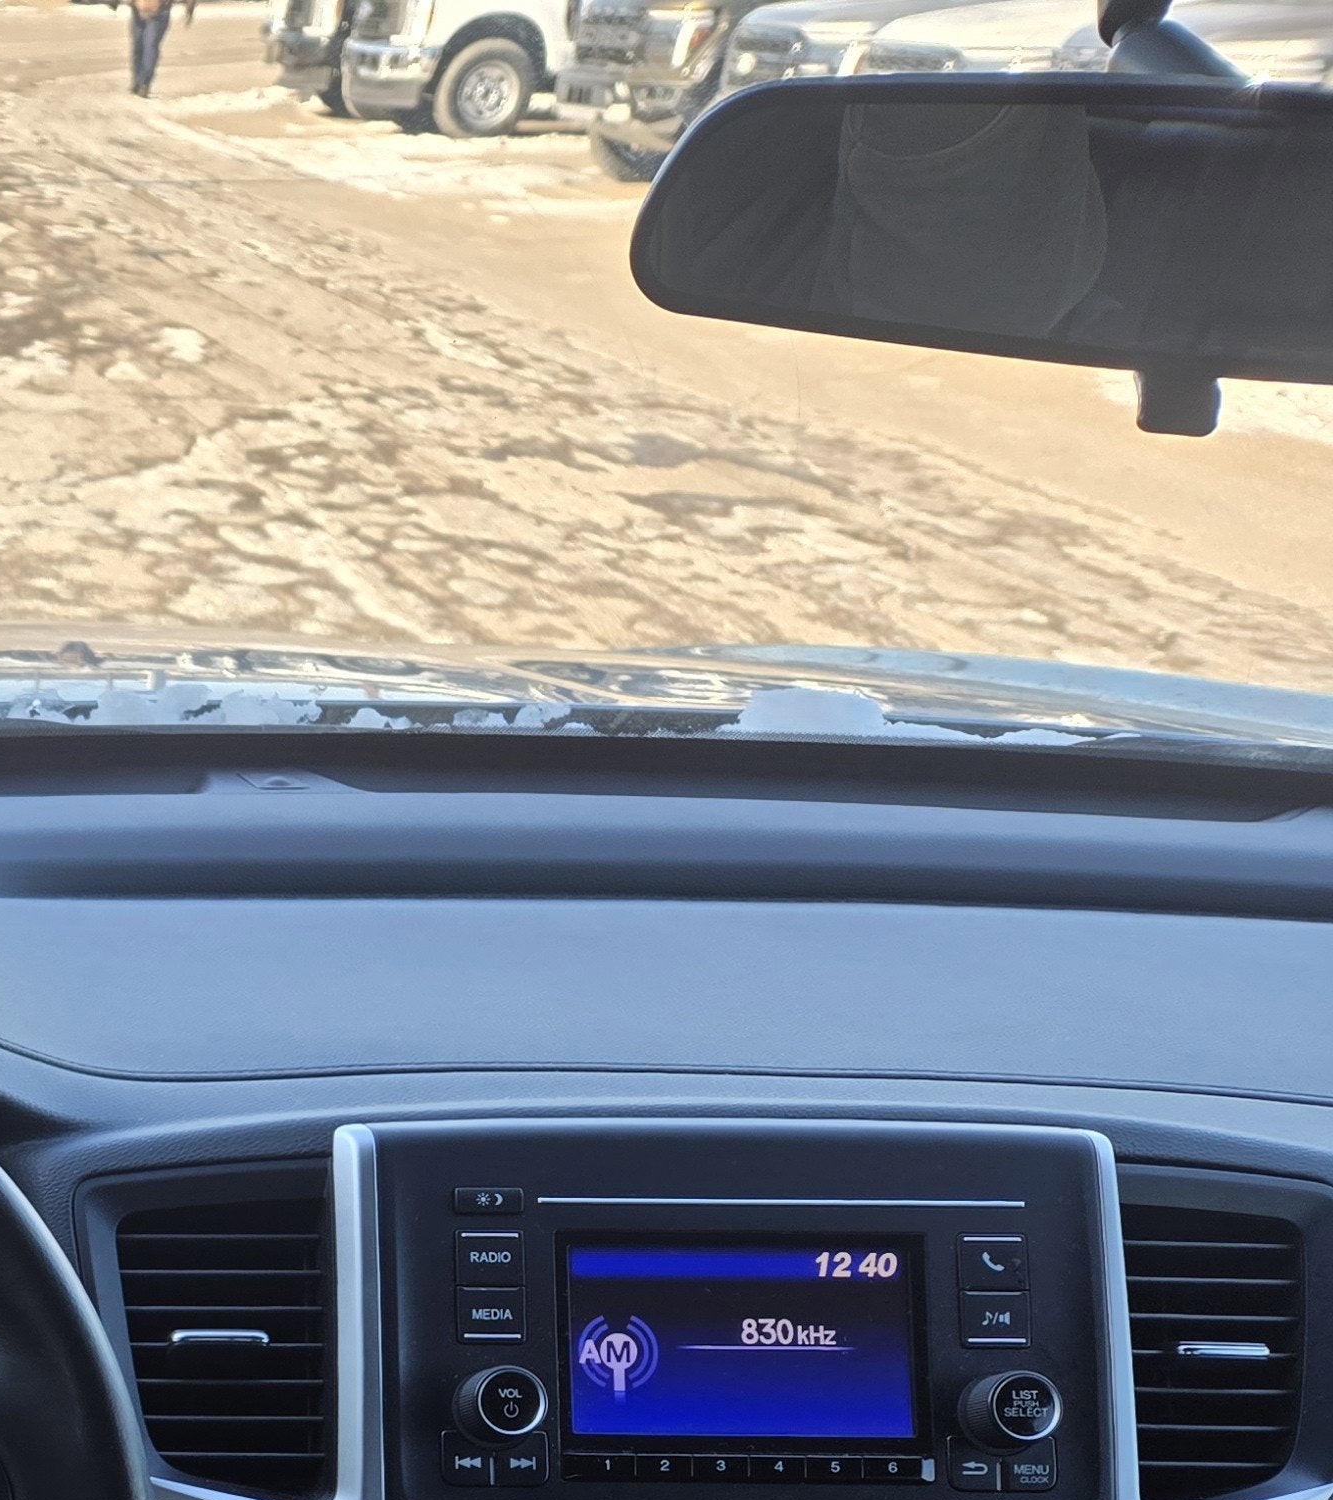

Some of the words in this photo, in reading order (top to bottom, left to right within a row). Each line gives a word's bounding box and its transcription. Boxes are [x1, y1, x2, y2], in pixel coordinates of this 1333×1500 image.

[469, 1251, 512, 1263] RADIO
[471, 1308, 514, 1320] MEDIA
[740, 1318, 795, 1345] 830
[796, 1324, 837, 1346] kHz
[498, 1388, 523, 1399] VOL
[1011, 1389, 1039, 1400] LIST
[1013, 1400, 1039, 1408] PUSH
[1003, 1407, 1049, 1418] SELECT
[604, 1459, 612, 1472] 1
[659, 1459, 671, 1472] 2
[715, 1459, 727, 1472] 3
[773, 1460, 785, 1473] 4
[830, 1460, 841, 1473] 5
[887, 1461, 899, 1473] 6
[1013, 1464, 1050, 1475] MENU
[1019, 1476, 1049, 1484] CLOCK
